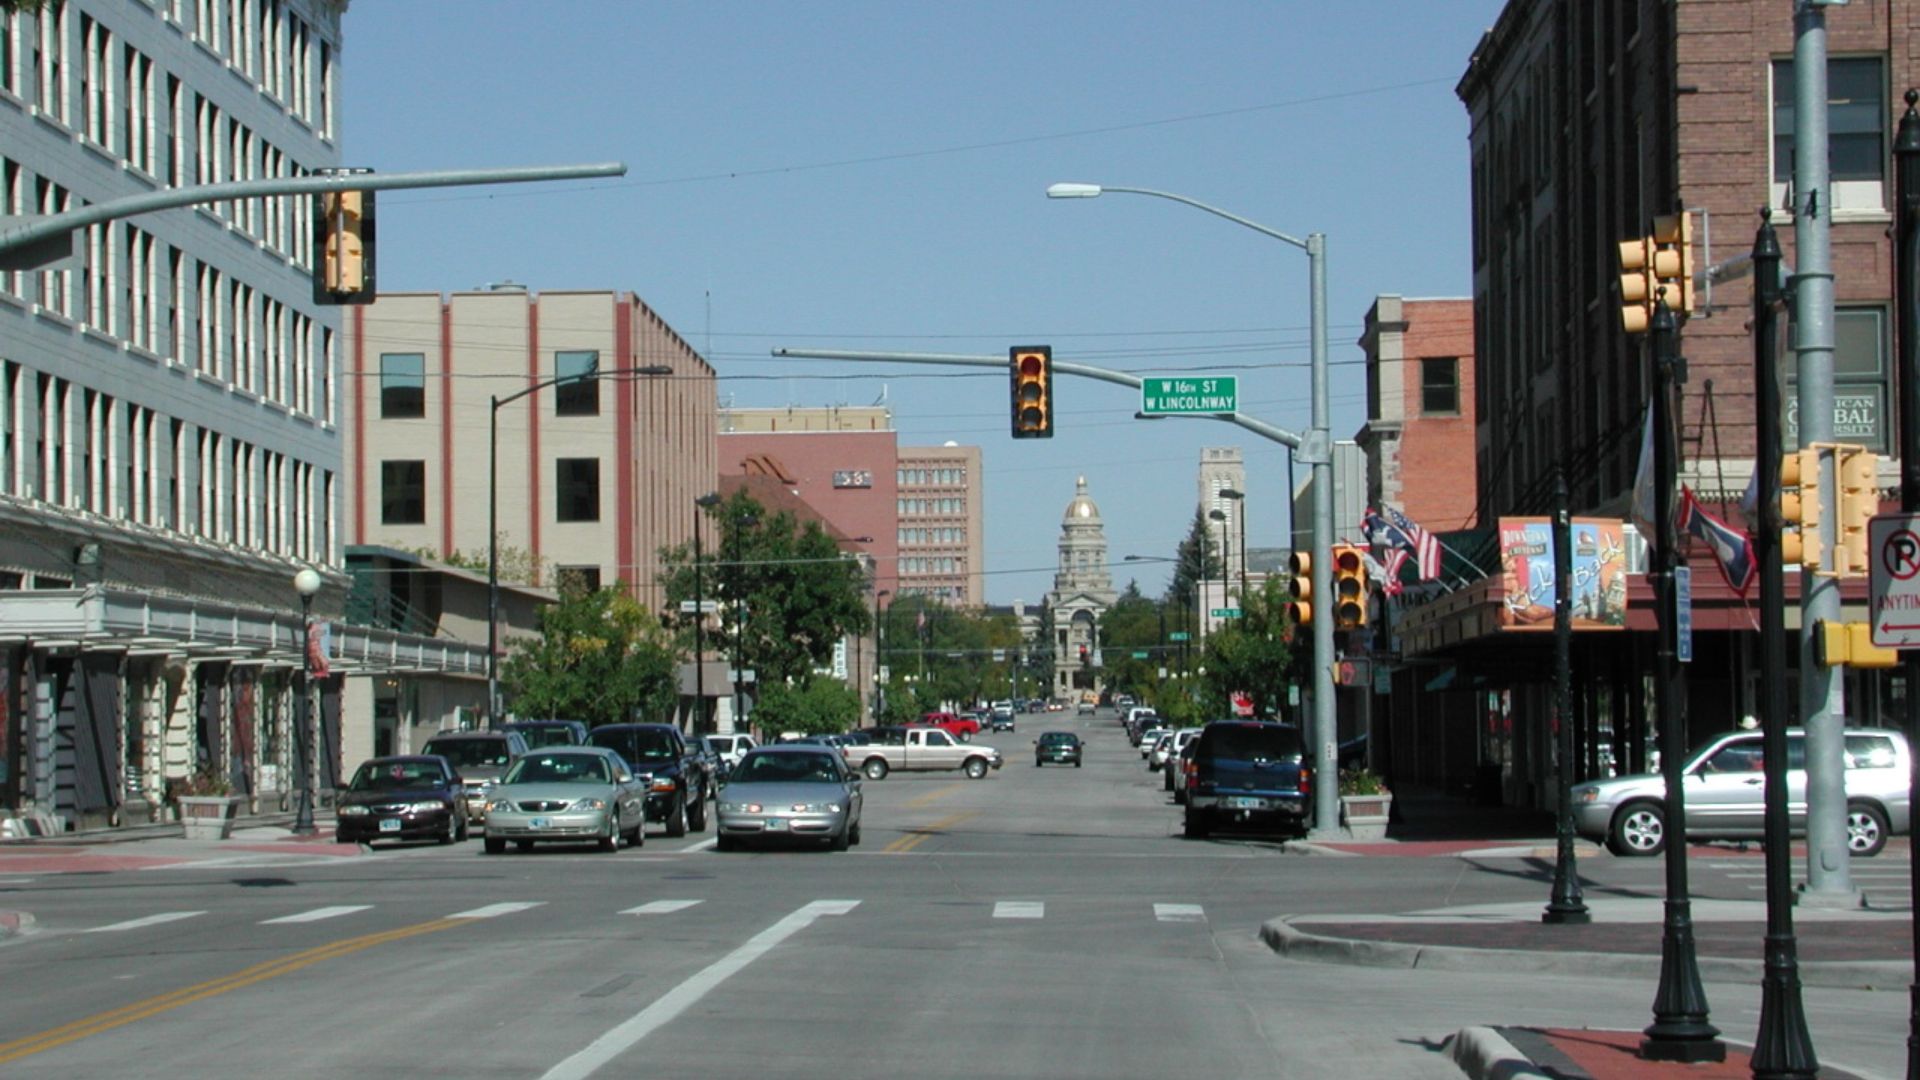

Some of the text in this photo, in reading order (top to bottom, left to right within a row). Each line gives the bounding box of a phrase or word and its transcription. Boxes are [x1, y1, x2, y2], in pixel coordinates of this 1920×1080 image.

[1161, 380, 1172, 393] W
[1202, 380, 1217, 393] ST
[1145, 396, 1234, 410] W LINCOLNWAY
